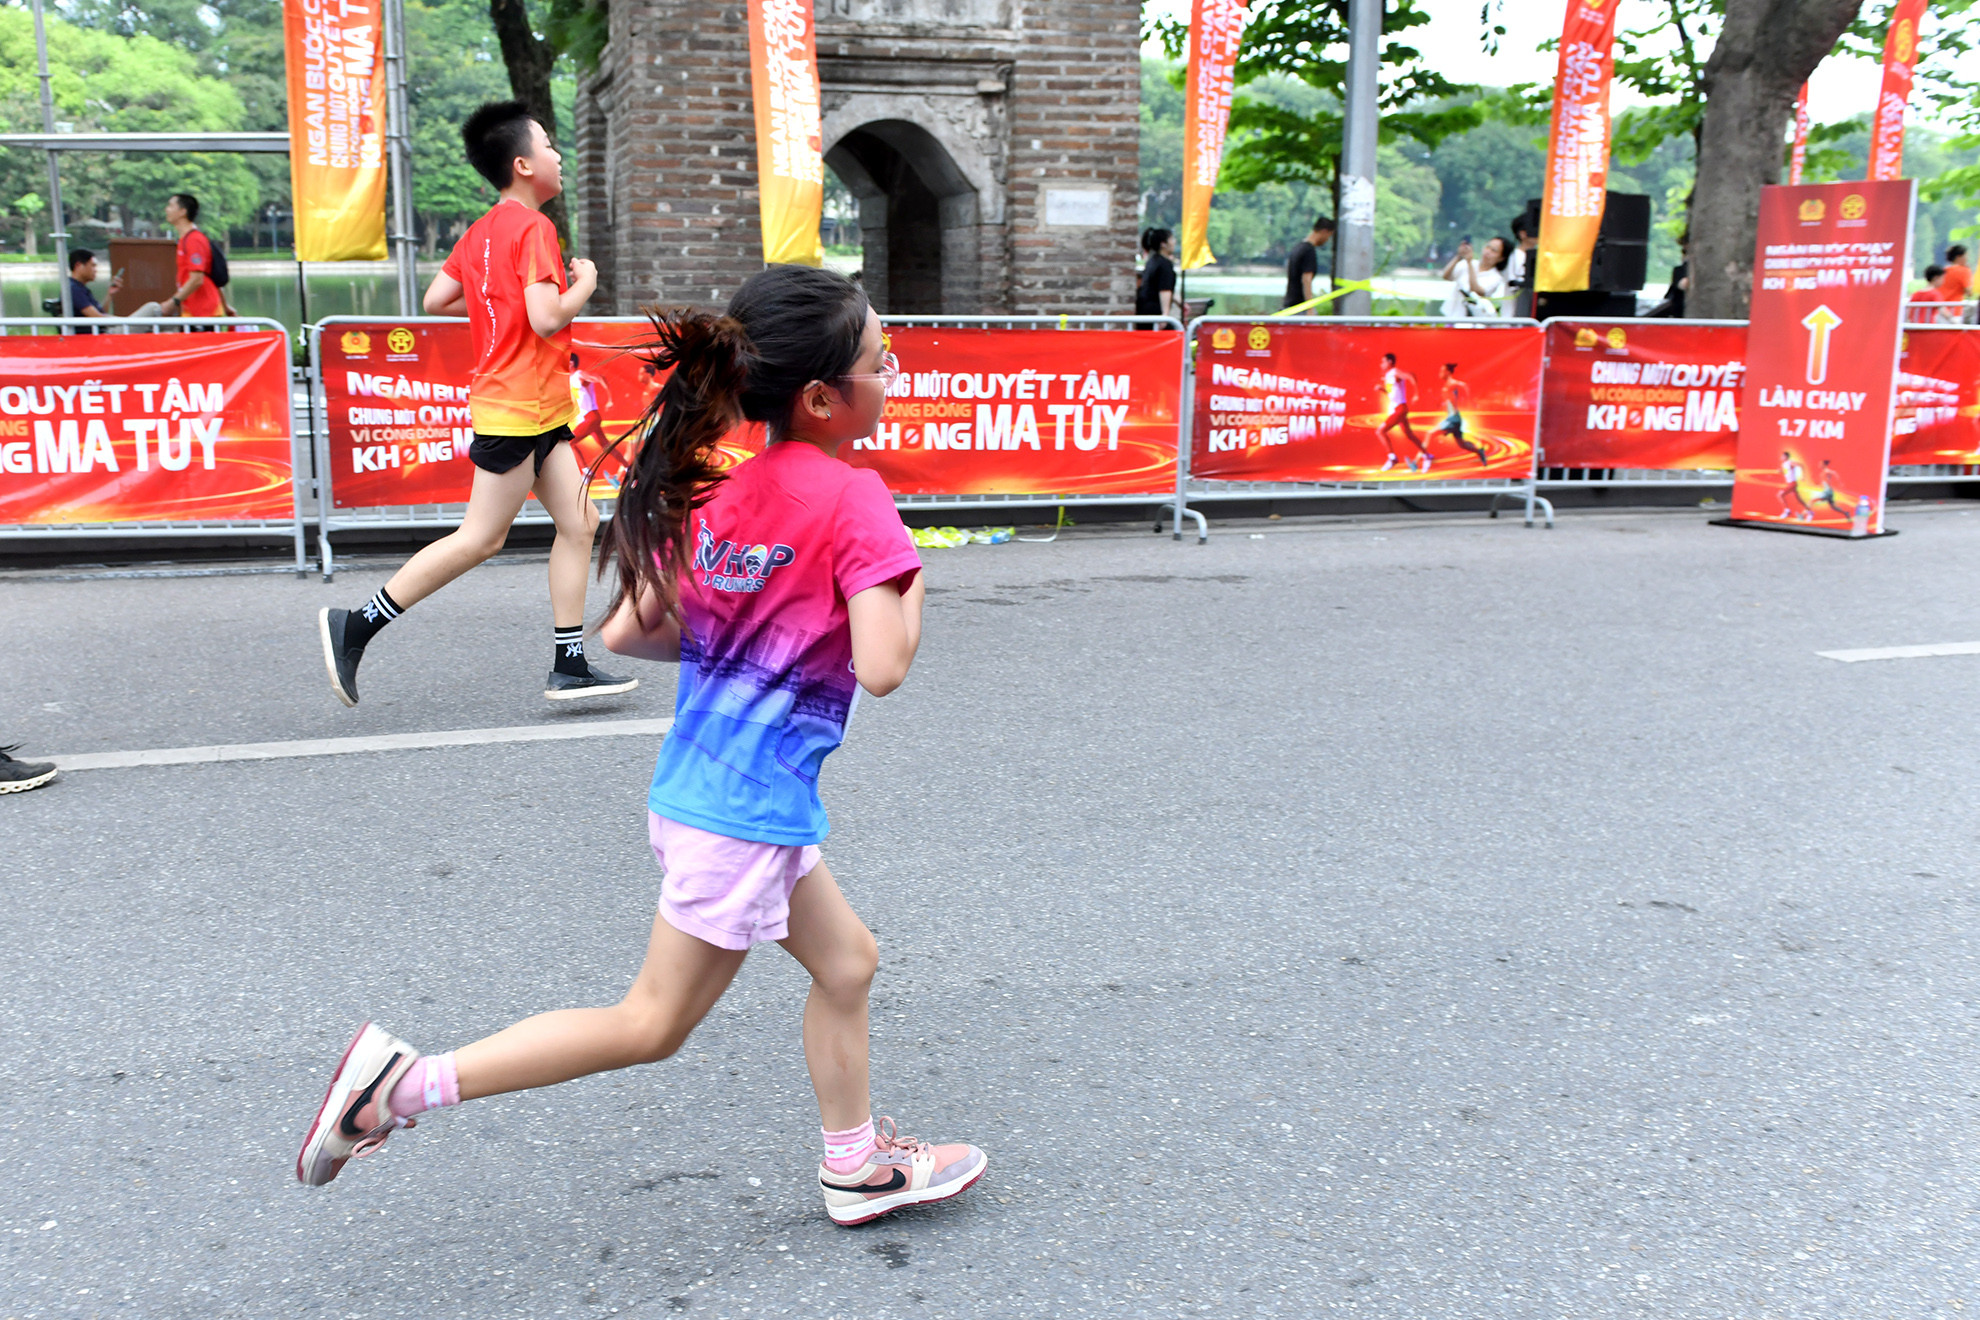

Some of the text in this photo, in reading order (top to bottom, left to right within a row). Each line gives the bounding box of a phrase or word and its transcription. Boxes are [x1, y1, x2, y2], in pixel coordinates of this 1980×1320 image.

[342, 25, 375, 76] MA
[1579, 101, 1605, 142] MA
[346, 371, 431, 401] NGÀN
[913, 369, 952, 400] MỘT
[950, 369, 1057, 400] QUYẾT
[1060, 369, 1131, 400] TÂM
[1212, 363, 1278, 392] NGÀN
[0, 378, 224, 415] QUYẾT TÂM
[880, 400, 921, 420] ỘNG
[1683, 389, 1740, 433] MA
[1758, 384, 1867, 415] LÀN CHẠY
[974, 403, 1042, 451] MA
[1047, 397, 1130, 452] TÚY
[1288, 414, 1318, 443] MA
[1777, 418, 1845, 440] 1.7 KM
[33, 419, 120, 474] MA
[123, 411, 224, 472] TÚY
[451, 427, 475, 458] M
